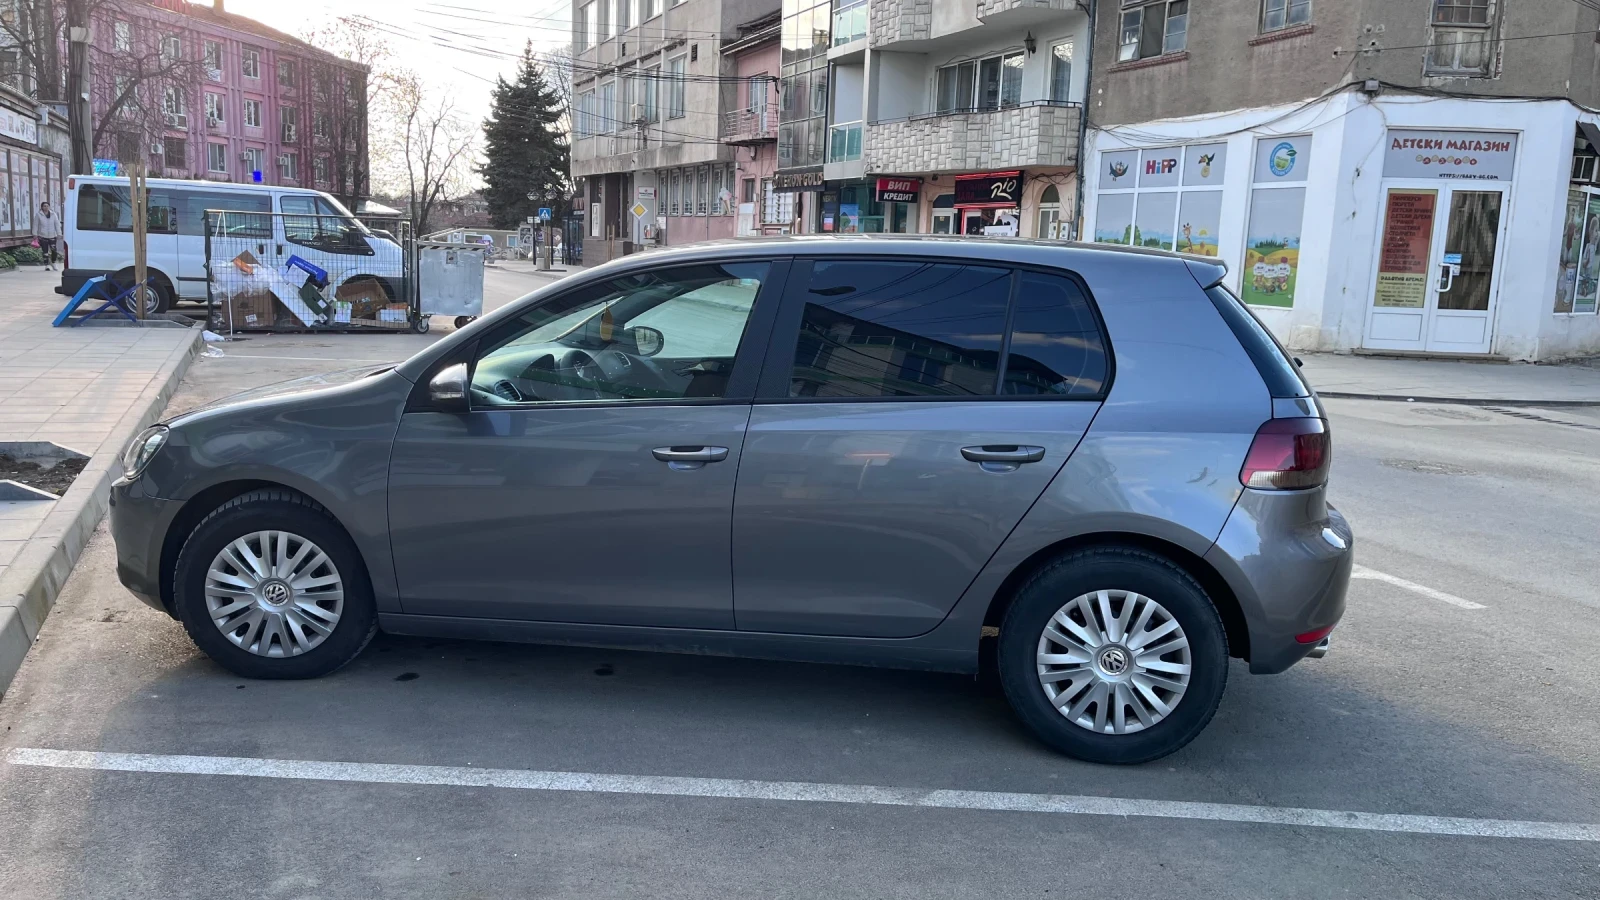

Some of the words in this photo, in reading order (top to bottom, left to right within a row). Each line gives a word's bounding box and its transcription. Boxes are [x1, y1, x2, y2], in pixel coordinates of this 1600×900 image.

[1391, 137, 1443, 150] ДЕТСКИ
[1446, 140, 1511, 152] МАГАЗИН
[1145, 158, 1177, 175] HiPP
[887, 181, 911, 191] ВИП
[883, 192, 913, 201] КРЕДИТ
